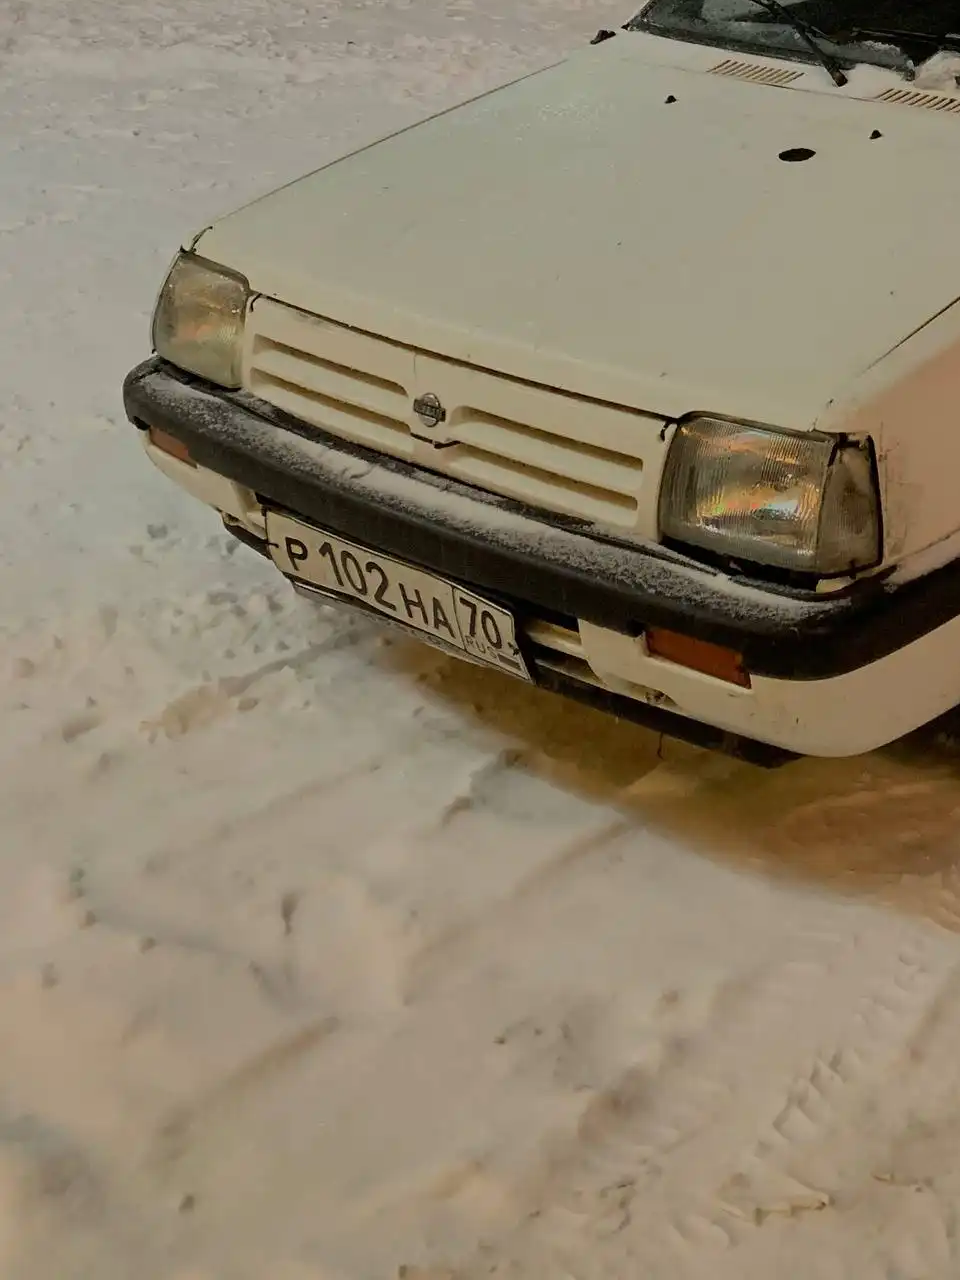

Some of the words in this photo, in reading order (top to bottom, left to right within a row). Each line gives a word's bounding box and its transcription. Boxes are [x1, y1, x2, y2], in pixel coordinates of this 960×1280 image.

[285, 536, 456, 638] Р102НА
[459, 597, 503, 650] 70
[464, 634, 500, 659] RUS
